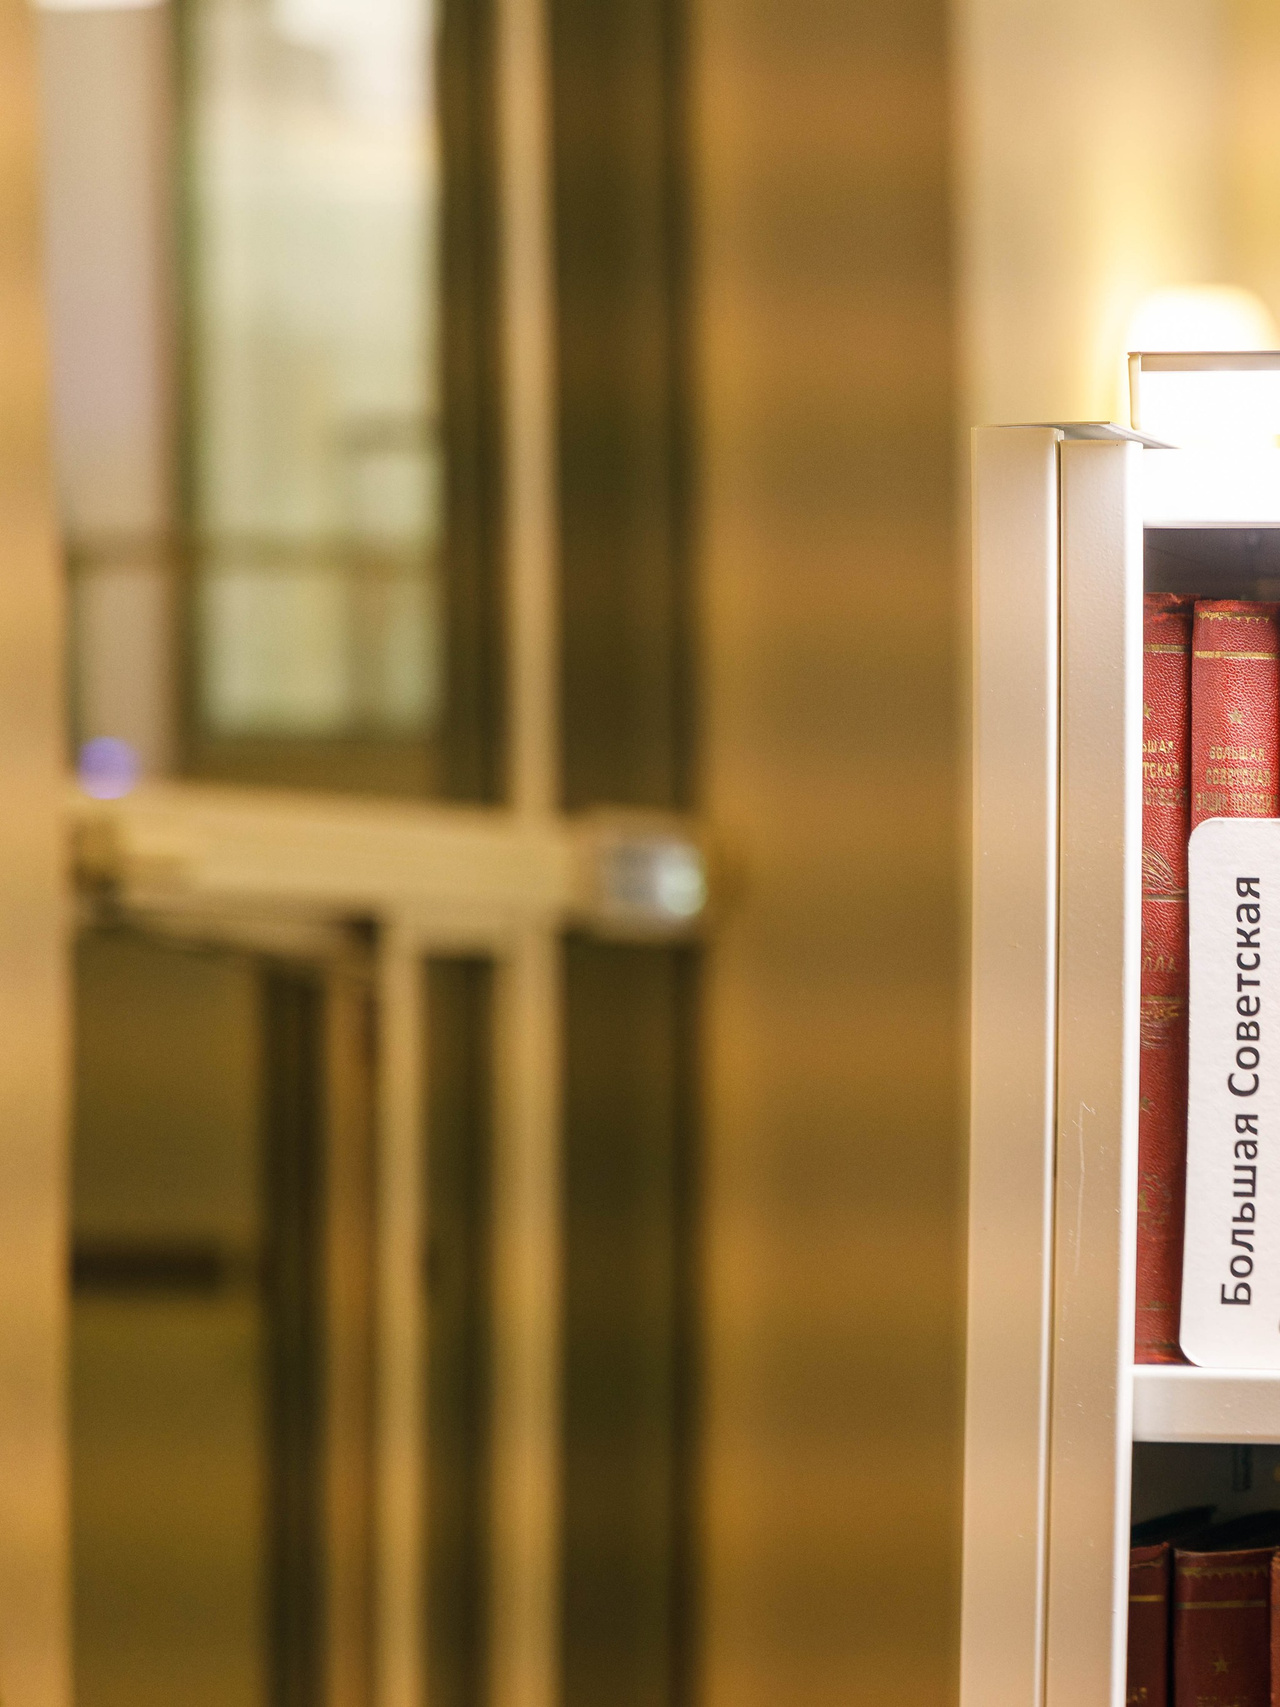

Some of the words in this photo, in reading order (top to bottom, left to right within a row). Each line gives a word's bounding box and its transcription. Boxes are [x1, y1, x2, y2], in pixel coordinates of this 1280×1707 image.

[1143, 739, 1175, 753] ЬШАЯ
[1143, 762, 1180, 778] ТСКАЯ
[1142, 955, 1176, 972] ЛЛА
[1228, 878, 1260, 1096] Советская
[1221, 1115, 1258, 1305] Большая
